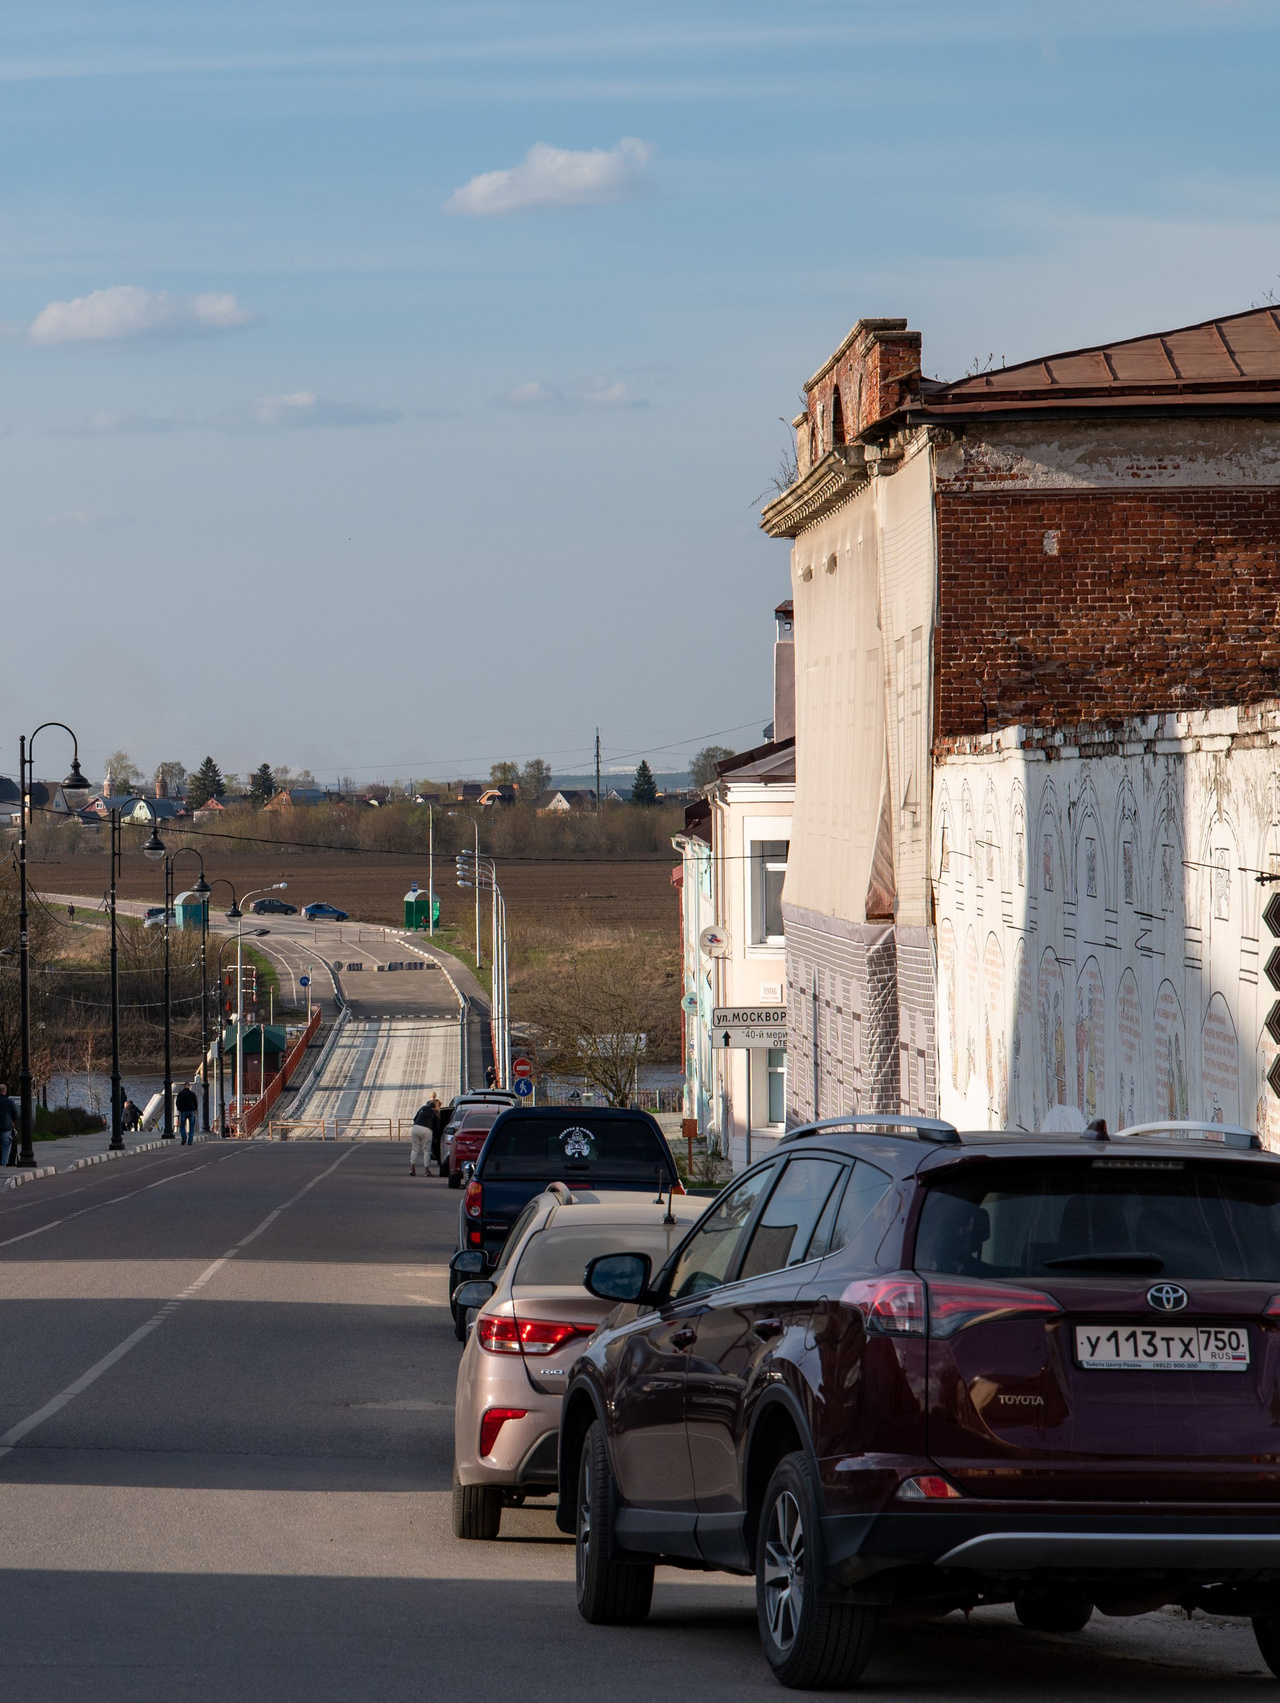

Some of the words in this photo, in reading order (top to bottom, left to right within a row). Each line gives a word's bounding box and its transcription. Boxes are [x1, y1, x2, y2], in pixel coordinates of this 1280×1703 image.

[1199, 1330, 1241, 1351] 750
[1211, 1351, 1231, 1360] RUS
[998, 1394, 1045, 1406] TOYOTA
